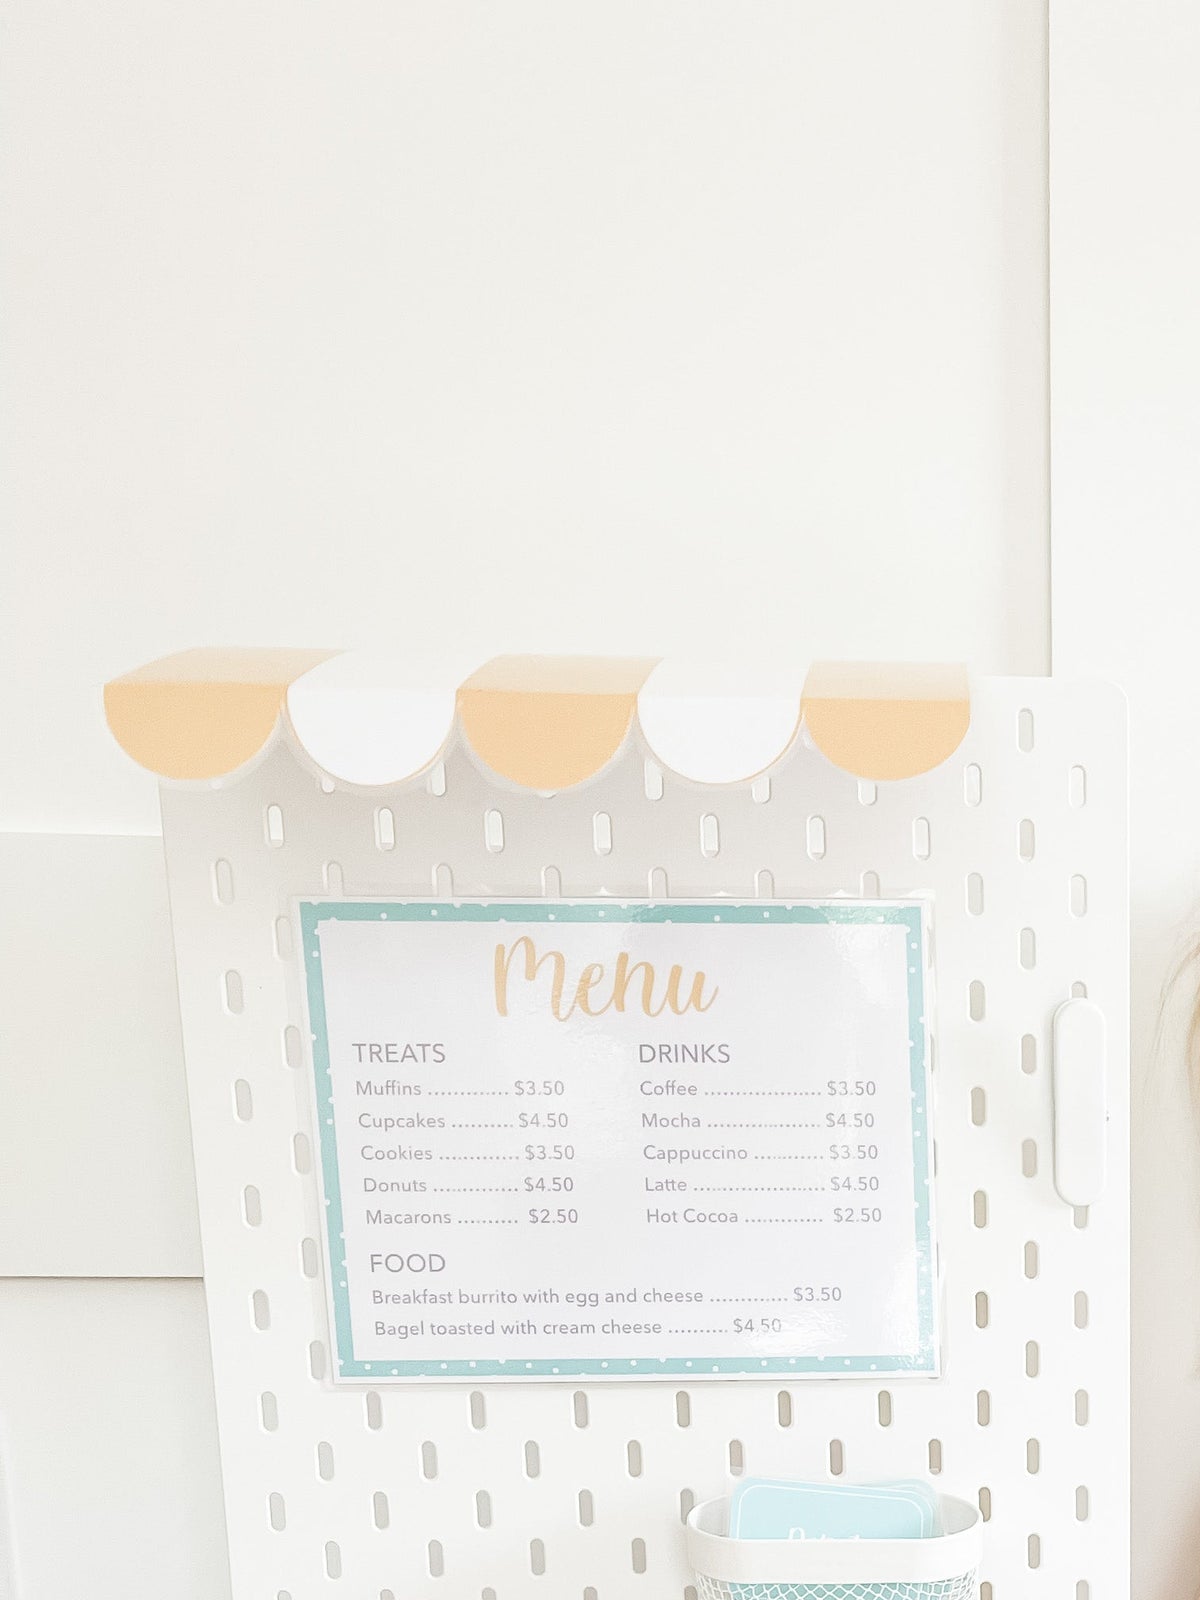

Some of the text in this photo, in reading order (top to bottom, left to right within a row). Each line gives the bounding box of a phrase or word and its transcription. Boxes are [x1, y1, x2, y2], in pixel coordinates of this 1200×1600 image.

[493, 935, 719, 1022] Menu
[351, 1042, 446, 1064] TREATS
[638, 1043, 731, 1064] DRINKS
[355, 1079, 565, 1097] Muffins $3.50
[639, 1079, 877, 1097] Coffee $3.50
[358, 1111, 569, 1133] Cupcakes $4.50
[641, 1111, 875, 1129] Mocha $4.50
[360, 1144, 575, 1161] Cookies $3.50
[642, 1143, 879, 1165] Cappuccino $3.50
[363, 1176, 574, 1193] Donuts $4.50
[644, 1176, 880, 1192] Latte $4.50
[365, 1207, 579, 1225] Macarons $2.50
[646, 1207, 882, 1224] Hot Cocoa $2.50
[369, 1253, 446, 1273] FOOD
[372, 1286, 842, 1308] Breakfast burrito with egg and cheese $3.50
[374, 1317, 782, 1340] Bagel toasted with cream cheese $4.50
